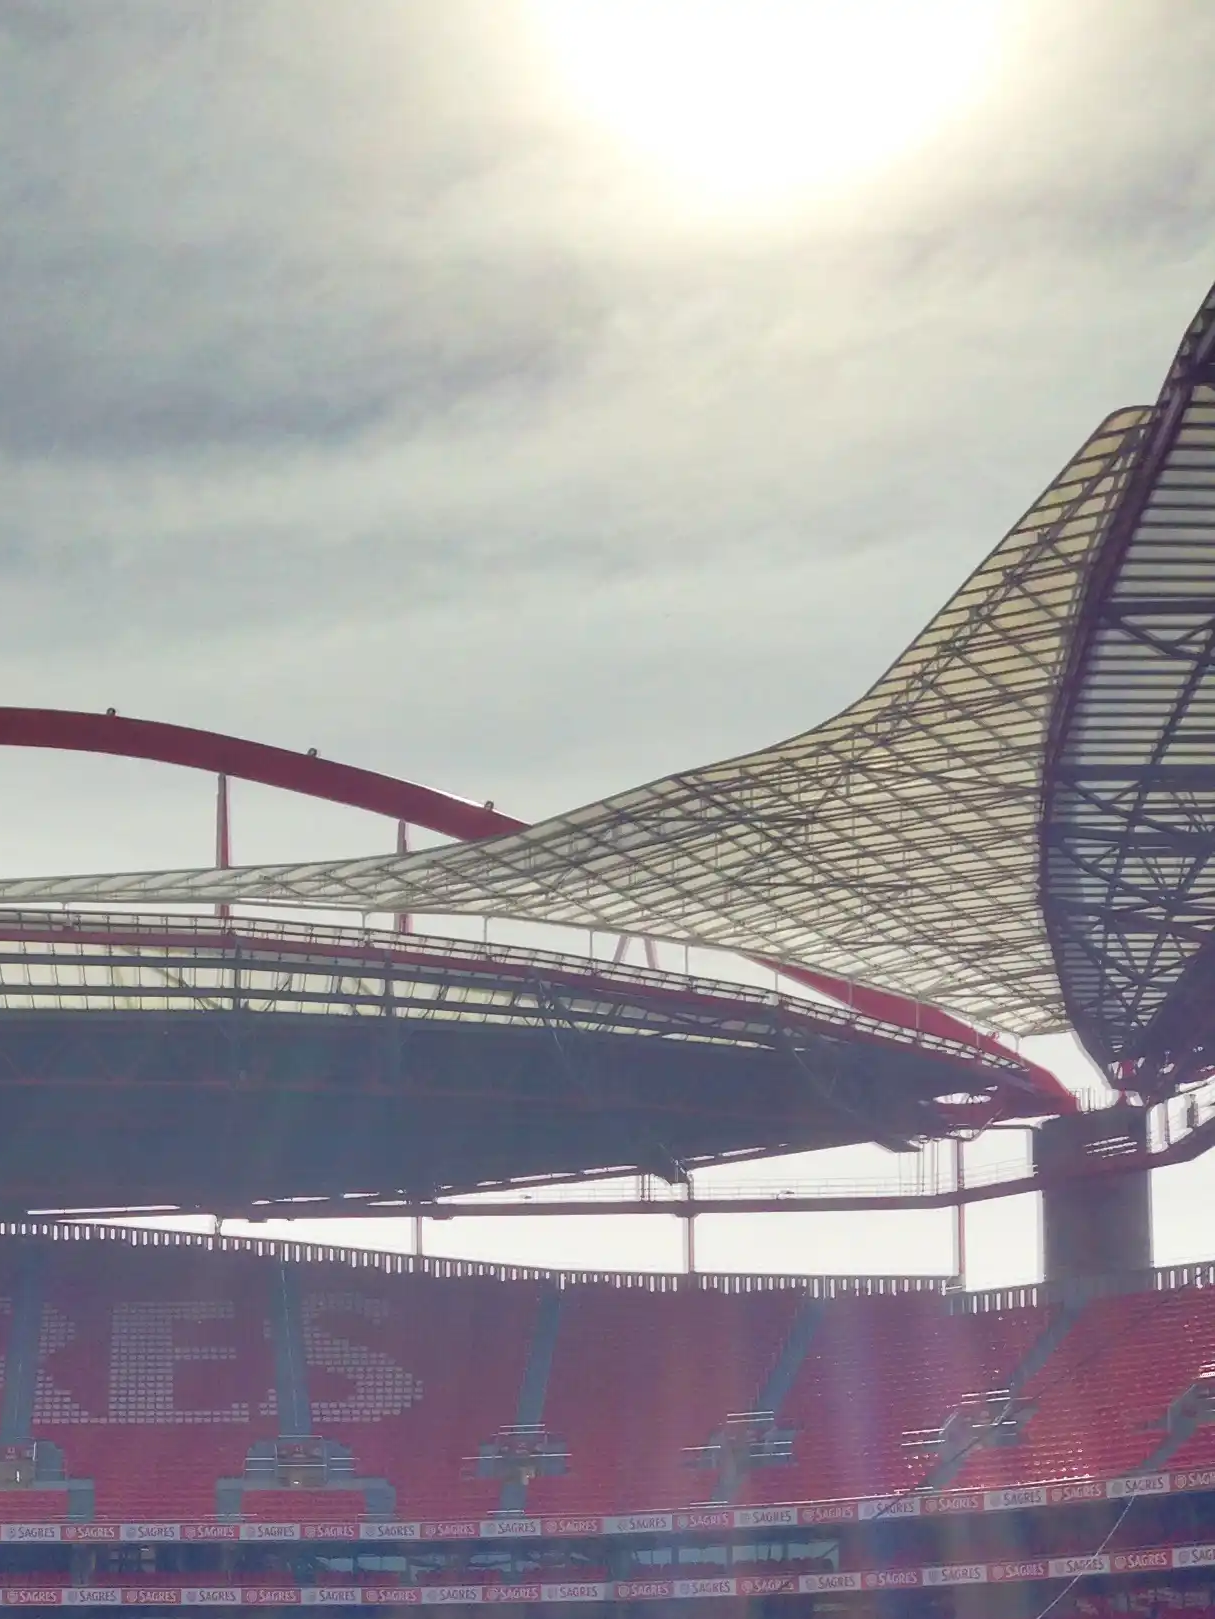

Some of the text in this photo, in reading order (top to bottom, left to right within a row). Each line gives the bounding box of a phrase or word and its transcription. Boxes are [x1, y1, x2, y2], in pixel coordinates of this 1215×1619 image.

[18, 1525, 55, 1539] SAGRES
[77, 1525, 115, 1539] SAGRES
[136, 1525, 175, 1538] SAGRES
[197, 1525, 234, 1538] SAGRES
[257, 1524, 294, 1537] SAGRES
[317, 1524, 354, 1537] SAGRES
[377, 1523, 415, 1537] SAGRES
[435, 1521, 475, 1535] SAGRES
[497, 1520, 536, 1534] SAGRES
[557, 1519, 597, 1532] SAGRES
[628, 1517, 667, 1531] SAGRES
[689, 1512, 729, 1527] SAGRES
[750, 1509, 791, 1523] SAGRES
[813, 1506, 854, 1520] SAGRES
[938, 1496, 978, 1510] SAGRES
[1002, 1491, 1042, 1506] SAGRES
[1062, 1486, 1102, 1500] SAGRES
[1125, 1476, 1164, 1492] SAGRES
[19, 1589, 57, 1603] SAGRES
[79, 1589, 116, 1603] SAGRES
[139, 1589, 176, 1603] SAGRES
[199, 1589, 236, 1603] SAGRES
[258, 1589, 296, 1603] SAGRES
[319, 1588, 355, 1602] SAGRES
[379, 1588, 417, 1602] SAGRES
[440, 1588, 478, 1601] SAGRES
[500, 1586, 539, 1599] SAGRES
[560, 1584, 598, 1598] SAGRES
[629, 1582, 669, 1596] SAGRES
[690, 1580, 731, 1594] SAGRES
[818, 1575, 856, 1589] SAGRES
[877, 1571, 917, 1585] SAGRES
[941, 1566, 981, 1581] SAGRES
[1003, 1563, 1044, 1577] SAGRES
[1128, 1553, 1167, 1567] SAGRES
